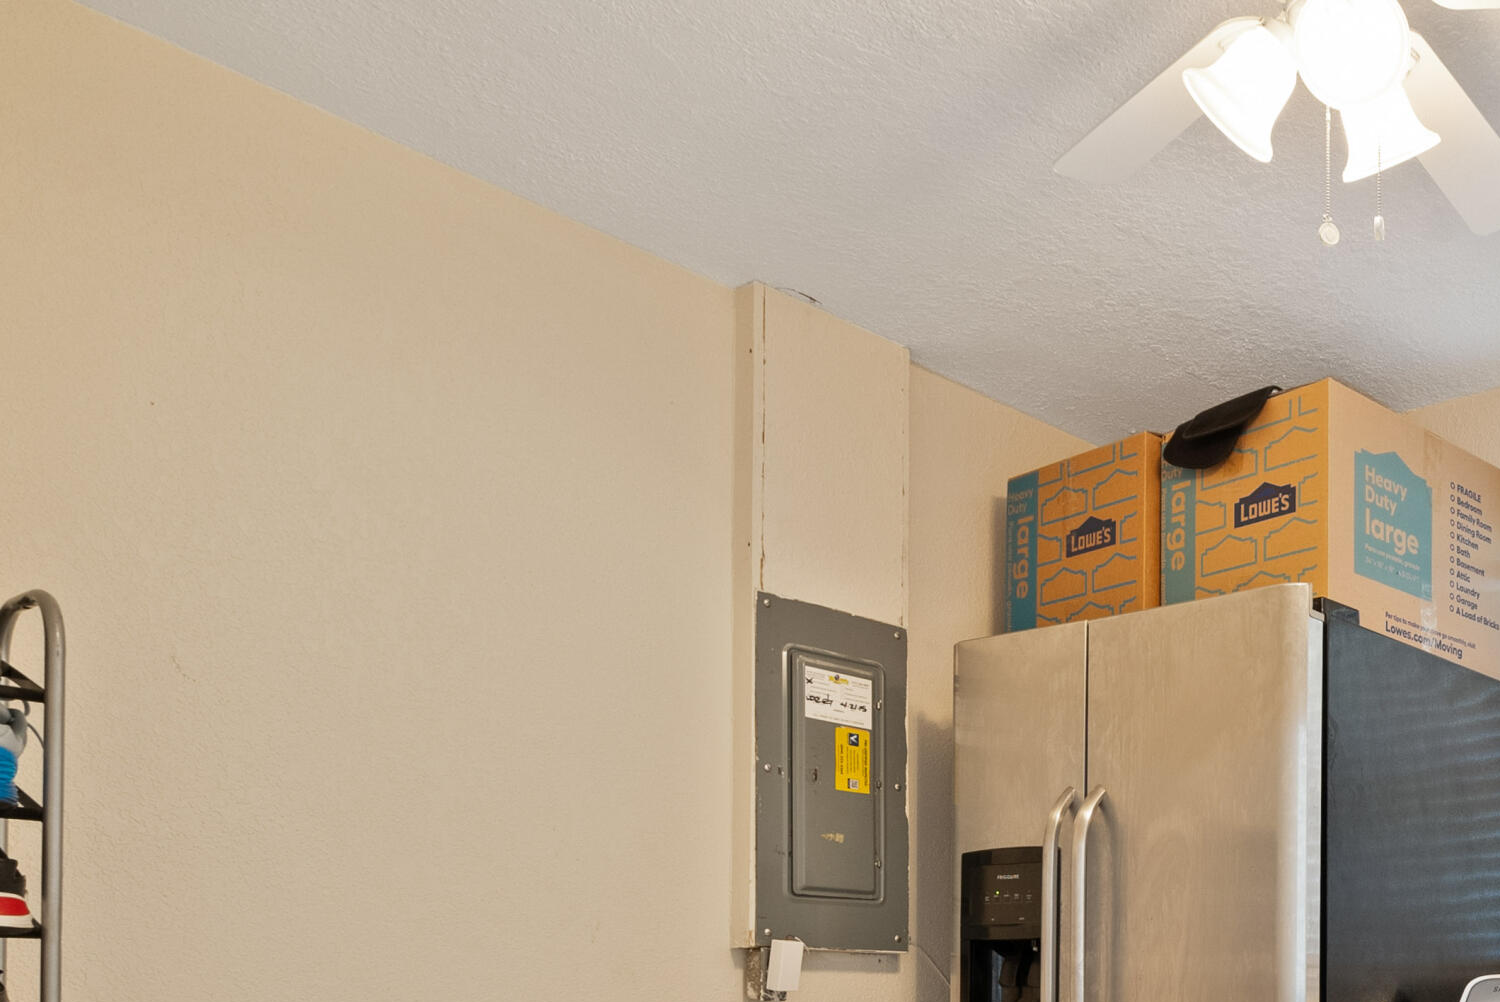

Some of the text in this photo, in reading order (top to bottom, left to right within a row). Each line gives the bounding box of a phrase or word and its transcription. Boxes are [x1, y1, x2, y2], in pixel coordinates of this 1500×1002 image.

[1364, 464, 1408, 502] Heavy
[1456, 484, 1482, 503] FRAGILE
[1008, 502, 1028, 516] Duty
[1240, 493, 1291, 522] LOWE'S
[1365, 485, 1397, 516] Duty
[1456, 497, 1482, 516] Bedroom
[1167, 480, 1191, 571] large
[1364, 507, 1419, 555] large
[1456, 509, 1493, 533] Family Room
[1071, 527, 1113, 553] LOWE'S
[1456, 521, 1492, 545] Dining Room
[1456, 533, 1479, 551] Kitchen
[1013, 515, 1034, 599] large
[1456, 546, 1471, 560] Bath
[1456, 558, 1485, 577] Basement
[1456, 570, 1471, 583] Attic
[1456, 582, 1481, 600] Laundry
[1456, 594, 1478, 610] Garage
[1461, 609, 1476, 622] Load
[1483, 616, 1500, 632] Bricks
[1385, 621, 1463, 659] Lowes.com/Moving
